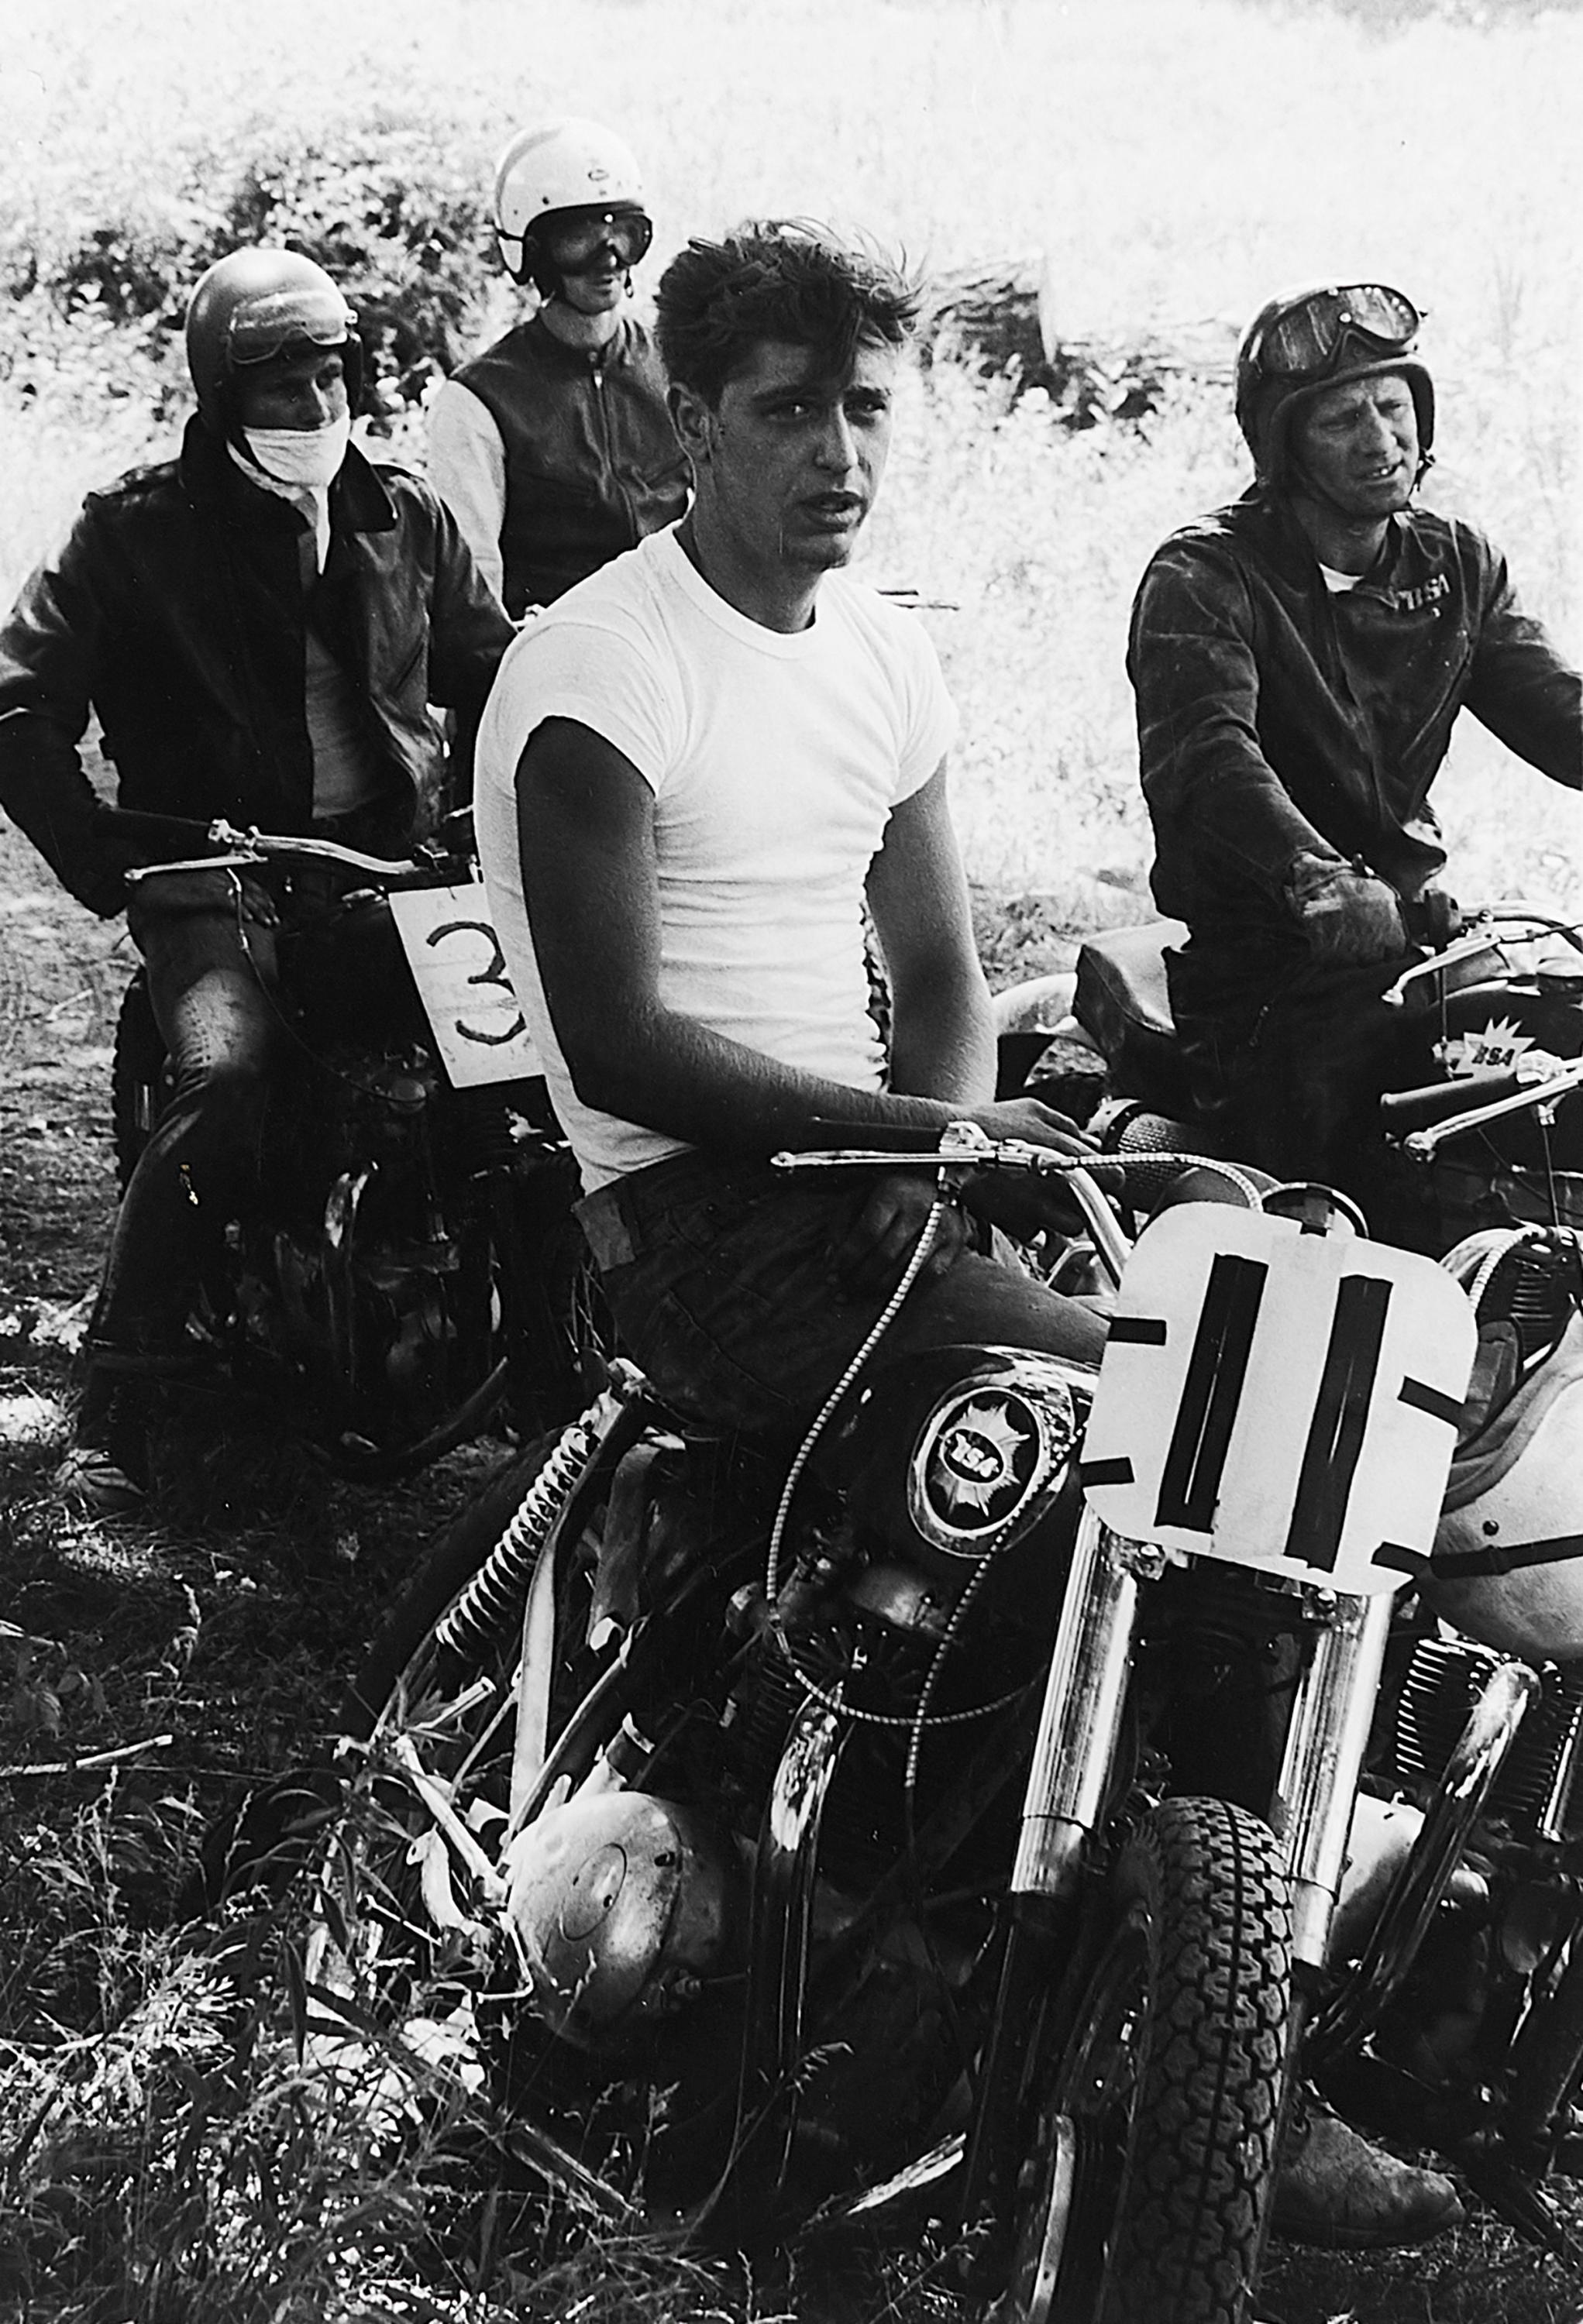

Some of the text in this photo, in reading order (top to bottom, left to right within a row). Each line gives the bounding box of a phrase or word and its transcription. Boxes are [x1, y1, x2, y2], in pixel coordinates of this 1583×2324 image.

[426, 921, 527, 1046] 3
[1472, 1047, 1515, 1066] BSA
[1154, 1253, 1394, 1573] 11
